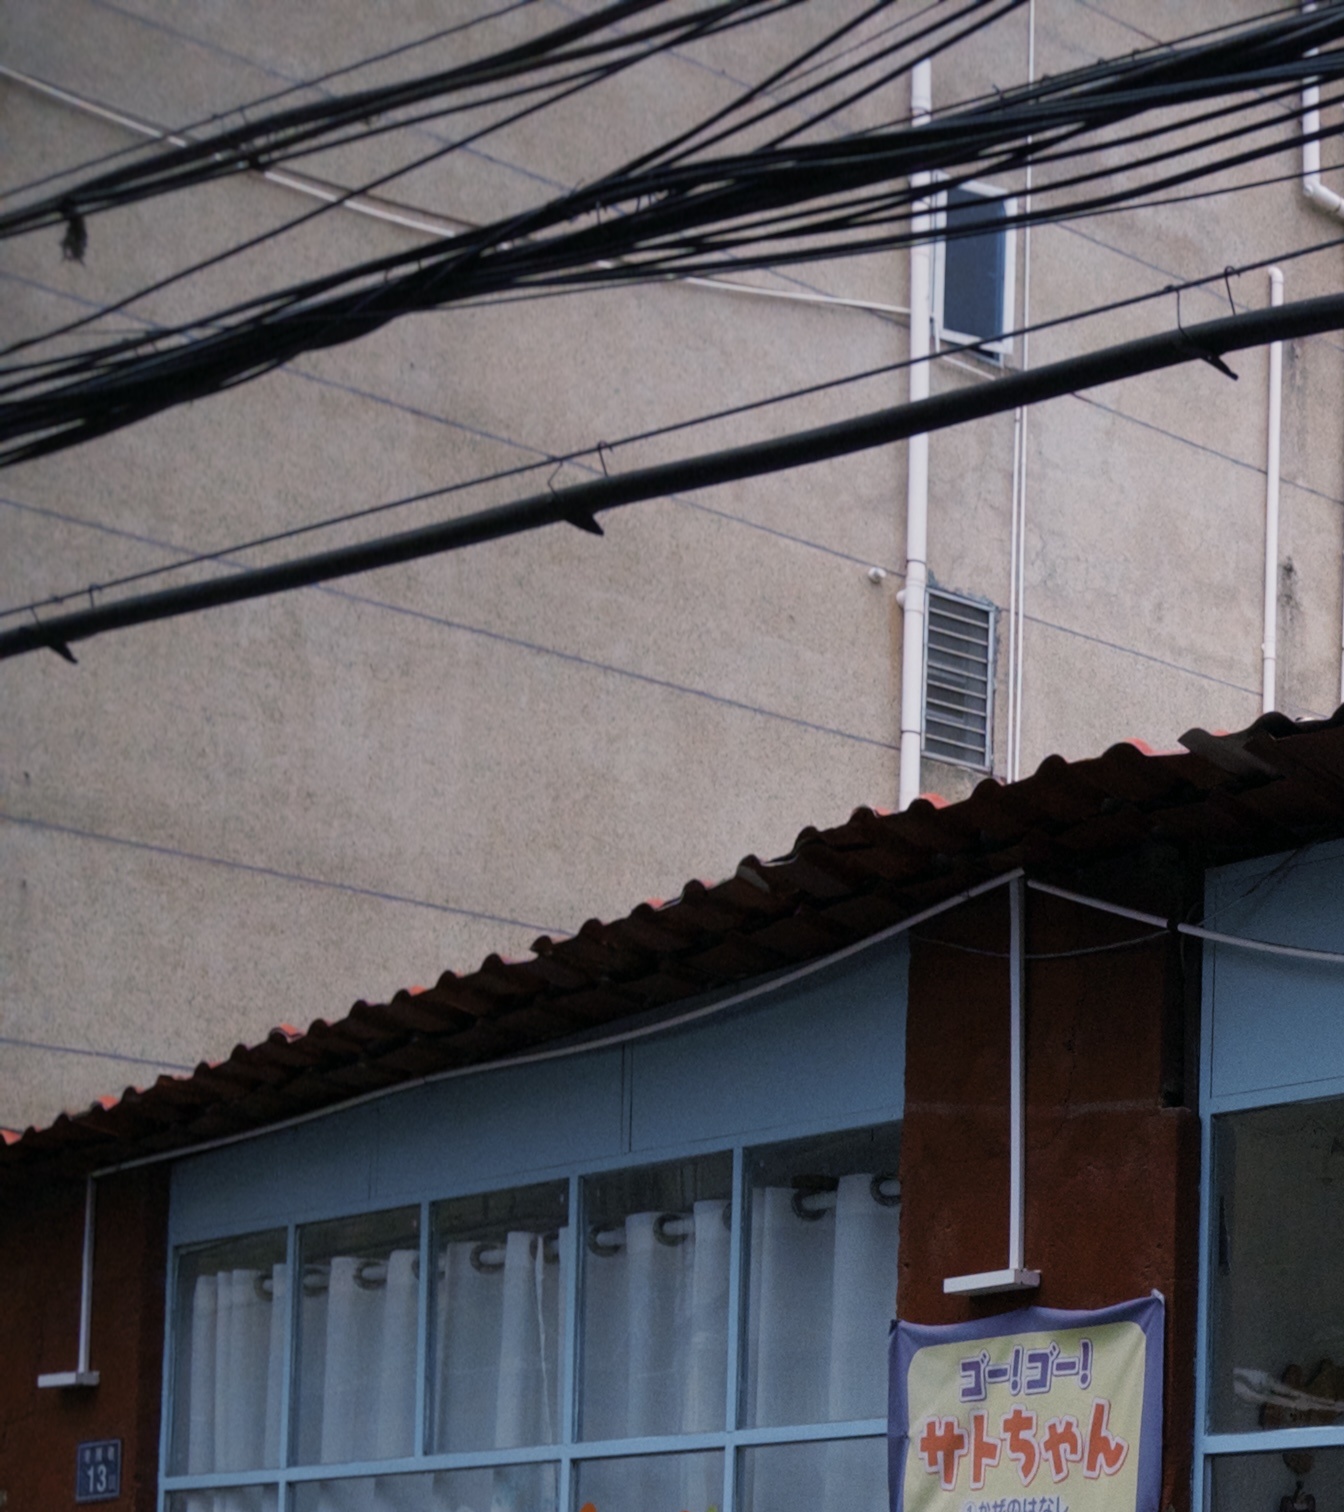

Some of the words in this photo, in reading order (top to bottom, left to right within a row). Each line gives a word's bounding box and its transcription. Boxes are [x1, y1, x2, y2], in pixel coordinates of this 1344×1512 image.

[919, 1398, 1128, 1491] サトちゃん
[87, 1463, 107, 1493] 13
